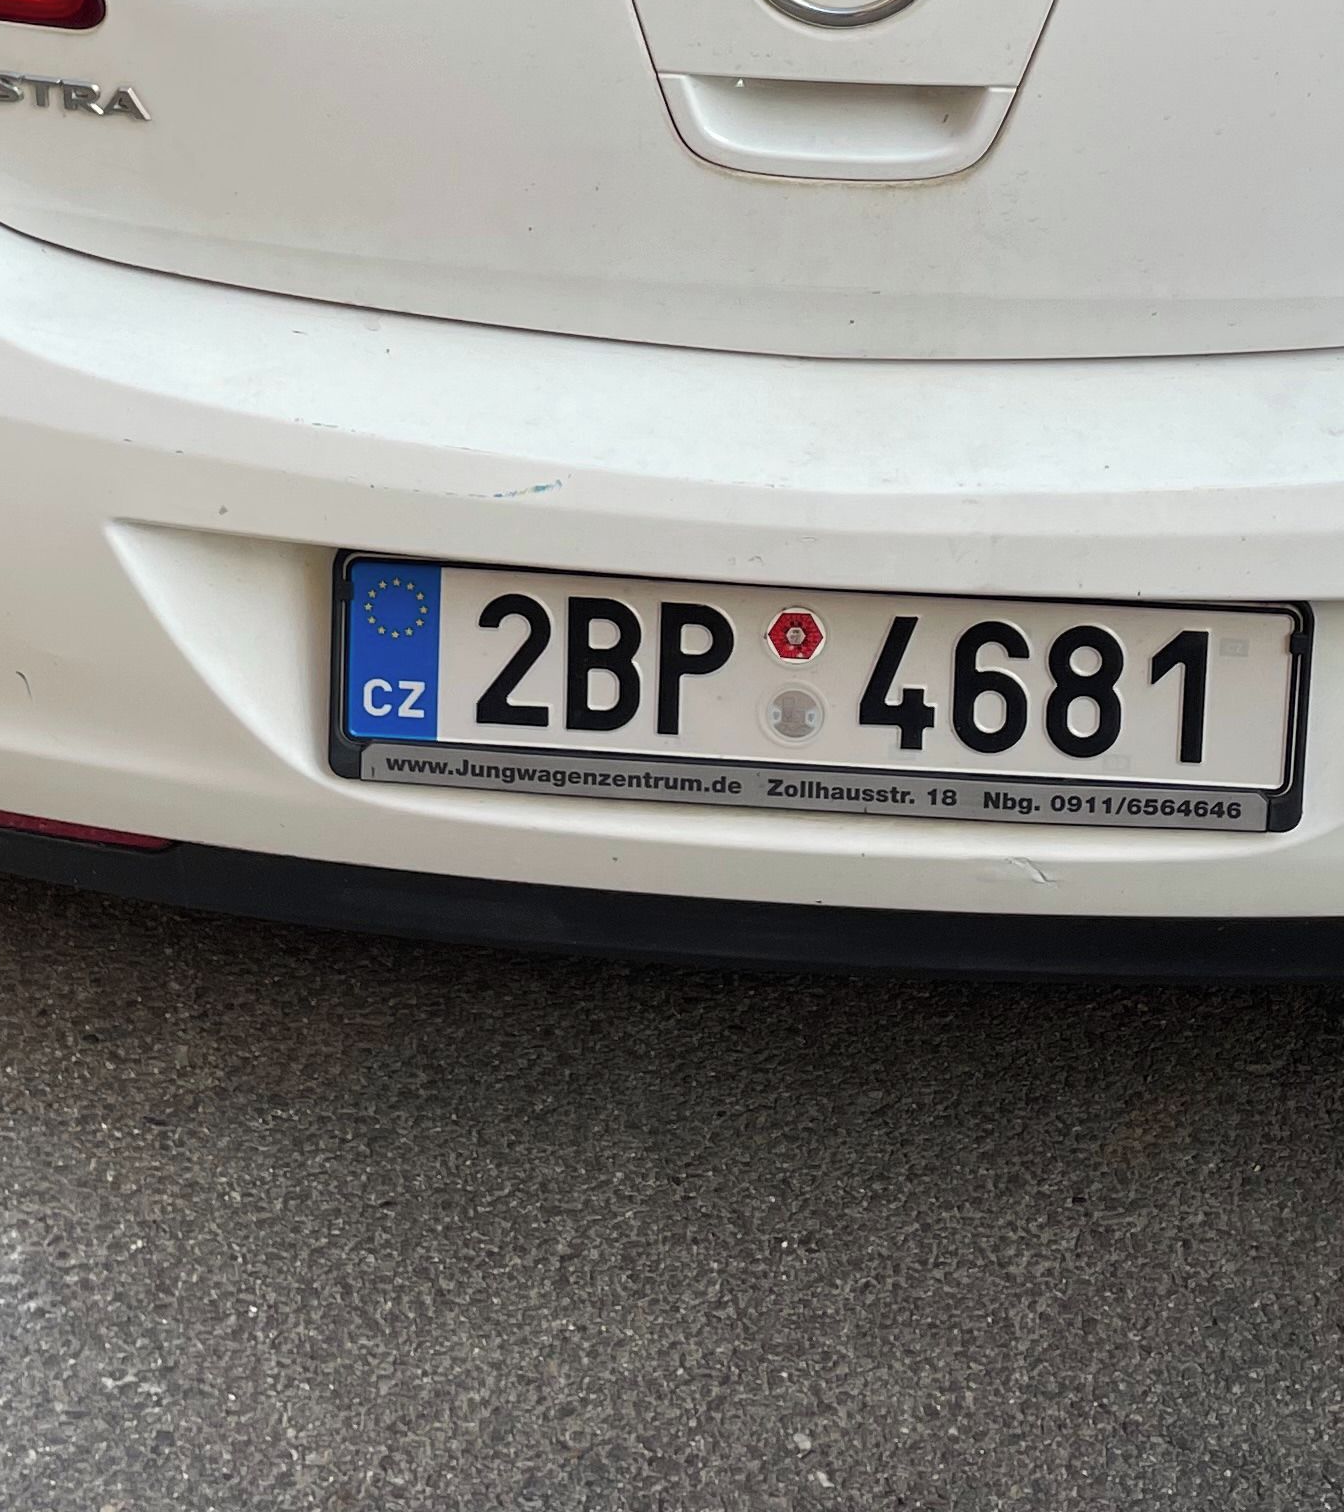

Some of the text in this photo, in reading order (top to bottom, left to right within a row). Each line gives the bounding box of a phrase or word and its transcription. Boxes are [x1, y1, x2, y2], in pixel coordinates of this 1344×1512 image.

[362, 593, 1210, 765] CZ 2BP 4681
[385, 755, 1243, 820] www.Jungwagenzentrum.de Zollhausstr. 18 Nbg. 0911/6564646
